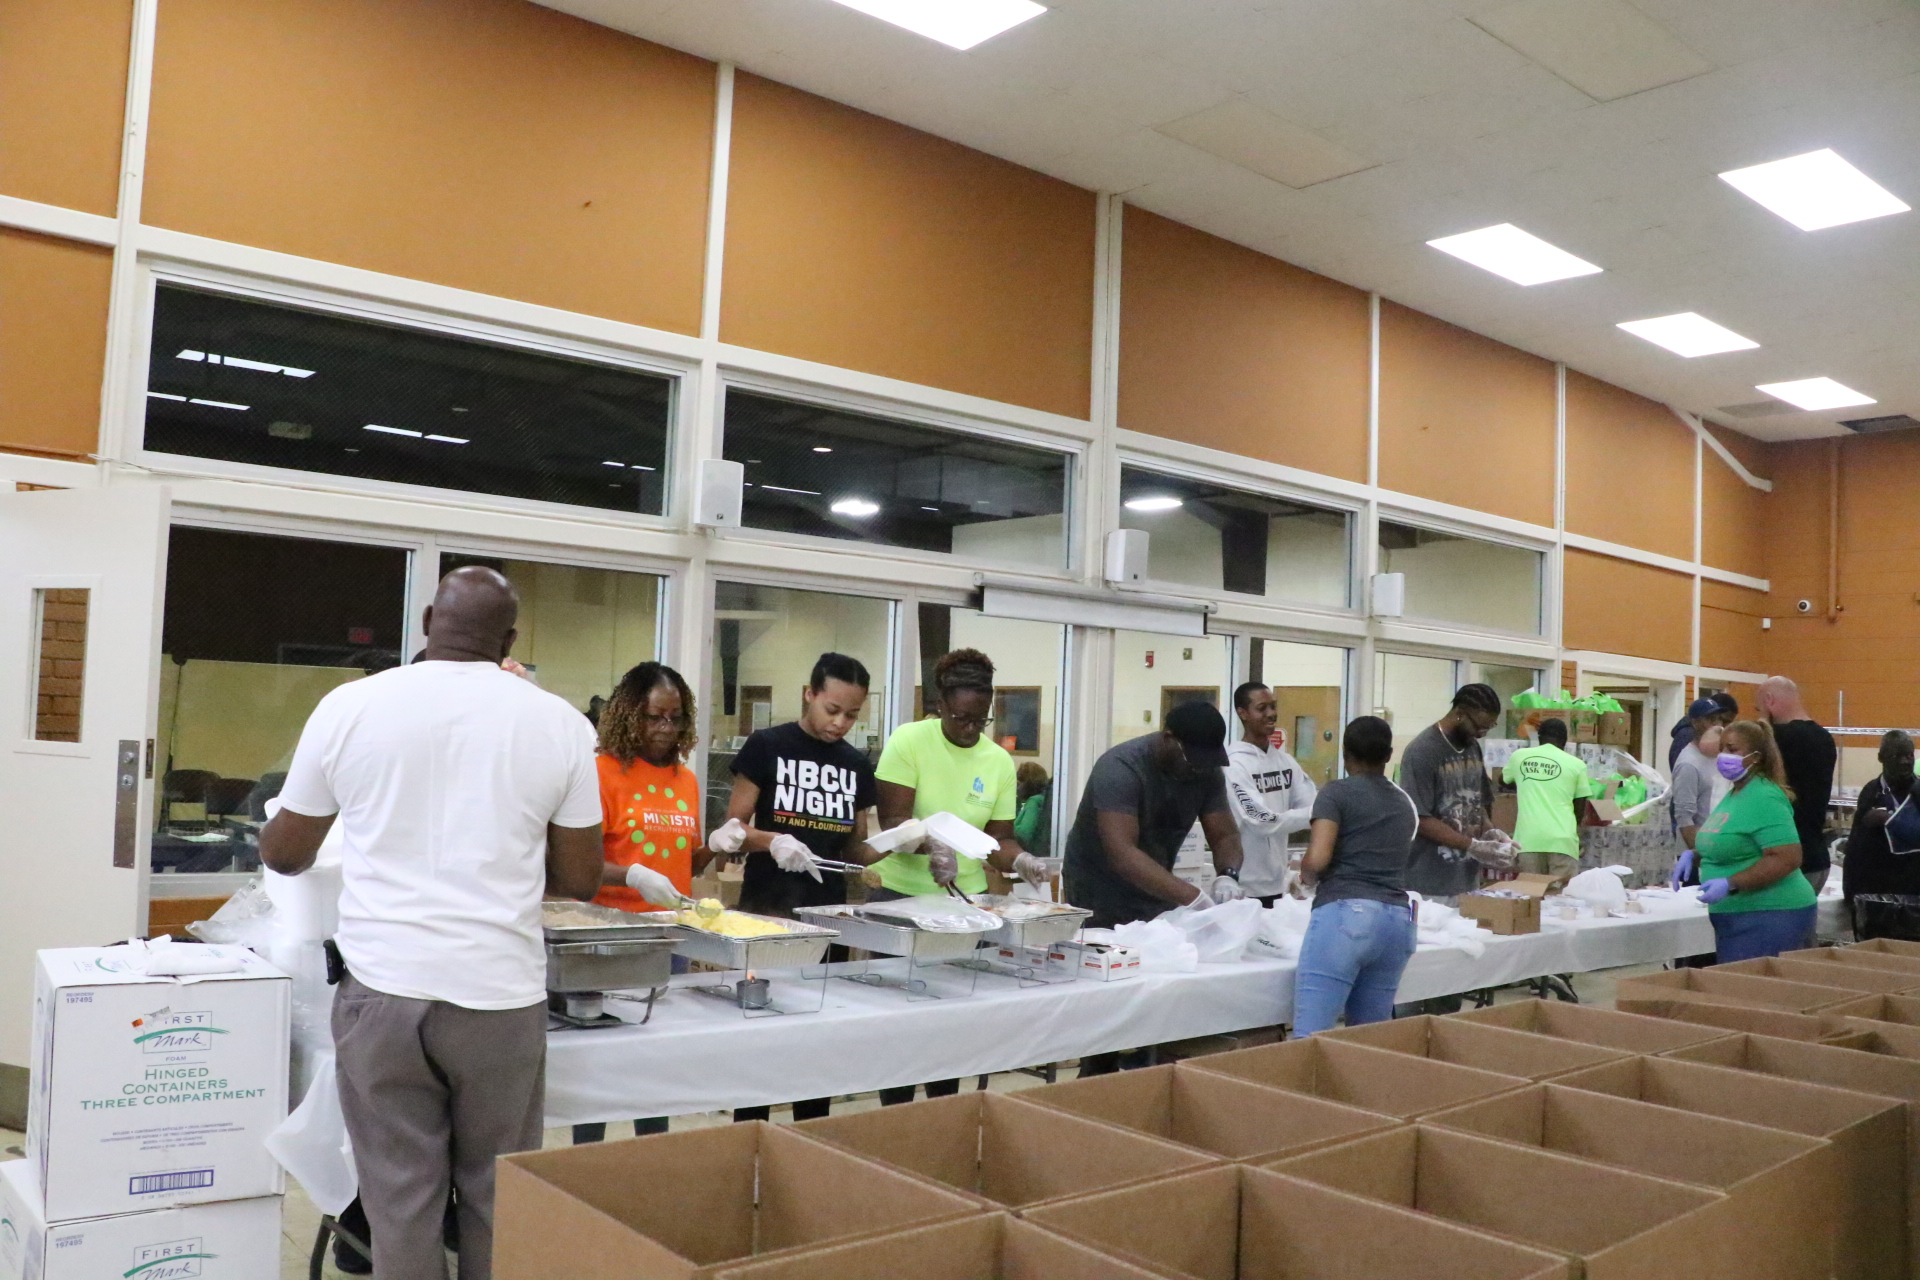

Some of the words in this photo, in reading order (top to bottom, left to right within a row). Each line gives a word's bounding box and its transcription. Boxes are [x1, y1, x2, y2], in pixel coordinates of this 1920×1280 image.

[776, 756, 857, 796] HBCU
[1524, 766, 1540, 774] ASK
[1543, 768, 1556, 776] ME
[773, 784, 855, 820] NIGHT
[643, 812, 696, 829] MINISTR
[788, 817, 806, 827] AND
[66, 996, 93, 1004] 197495
[149, 1032, 203, 1048] Mark
[145, 1067, 210, 1081] HINGED
[122, 1079, 228, 1095] CONTAINERS
[80, 1098, 138, 1110] THREE
[143, 1088, 266, 1105] COMPARTMENT
[55, 1239, 83, 1249] 197495
[142, 1244, 195, 1259] FIRST
[140, 1262, 197, 1280] Mark
